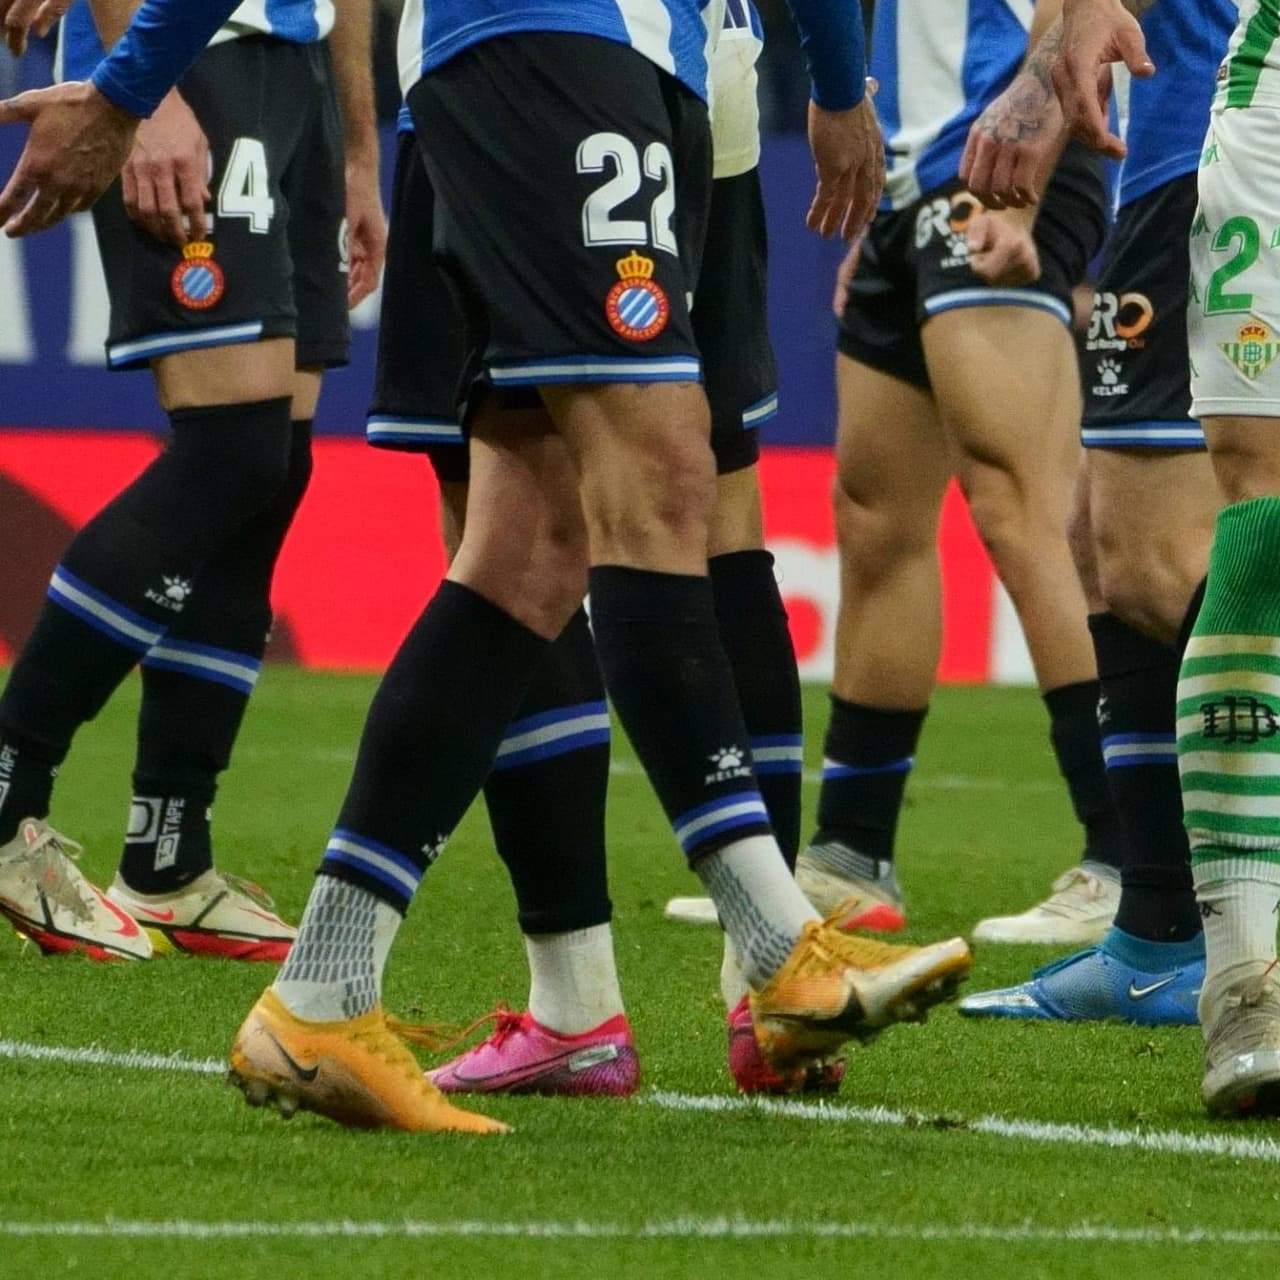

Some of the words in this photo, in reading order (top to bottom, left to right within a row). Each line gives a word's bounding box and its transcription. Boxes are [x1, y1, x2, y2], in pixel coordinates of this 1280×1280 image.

[183, 137, 275, 235] 4
[575, 132, 679, 258] 22
[1092, 384, 1129, 396] KELME
[706, 767, 752, 785] KELME
[164, 797, 185, 834] TAPE
